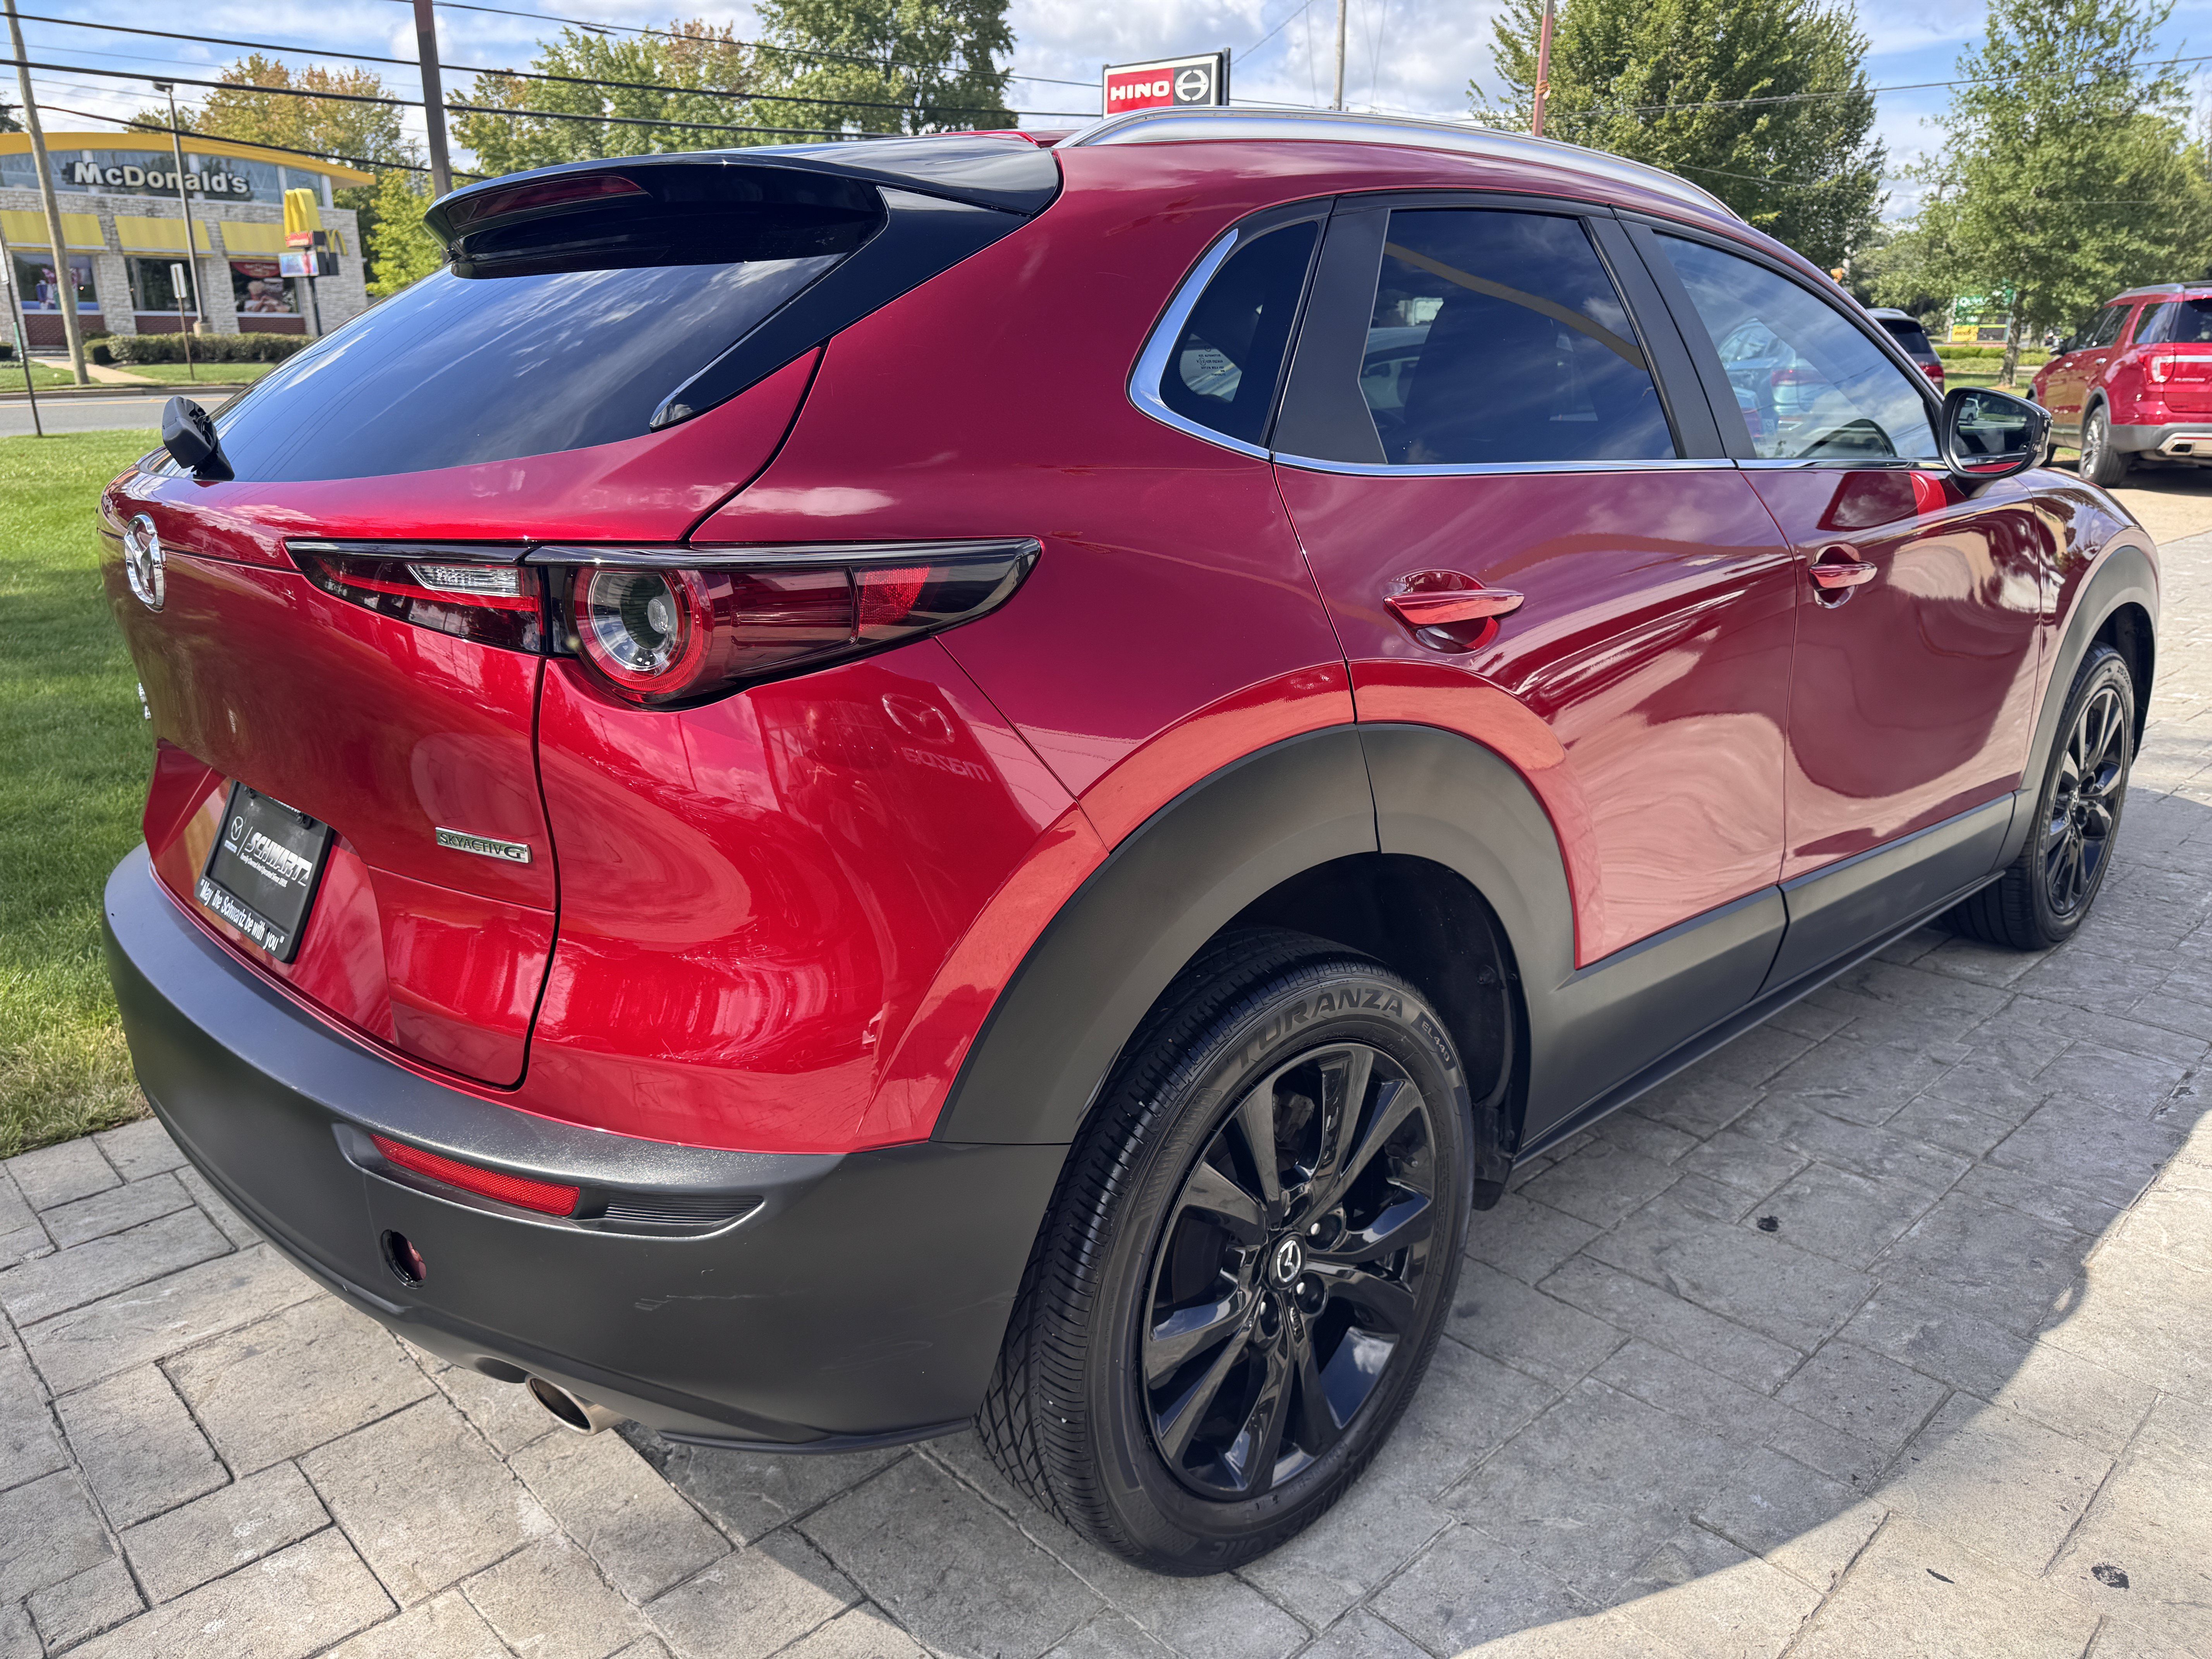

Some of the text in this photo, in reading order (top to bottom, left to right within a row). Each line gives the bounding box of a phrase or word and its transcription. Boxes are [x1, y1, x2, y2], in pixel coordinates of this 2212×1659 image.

[1110, 81, 1170, 101] HINO
[74, 161, 250, 195] McDonald's
[244, 832, 313, 886] SCHWARTZ
[211, 890, 223, 910] the
[221, 896, 247, 928] Schwartz
[244, 912, 254, 933] be
[251, 921, 266, 941] with
[1228, 988, 1404, 1069] TURANZA
[1421, 1019, 1451, 1063] EL440
